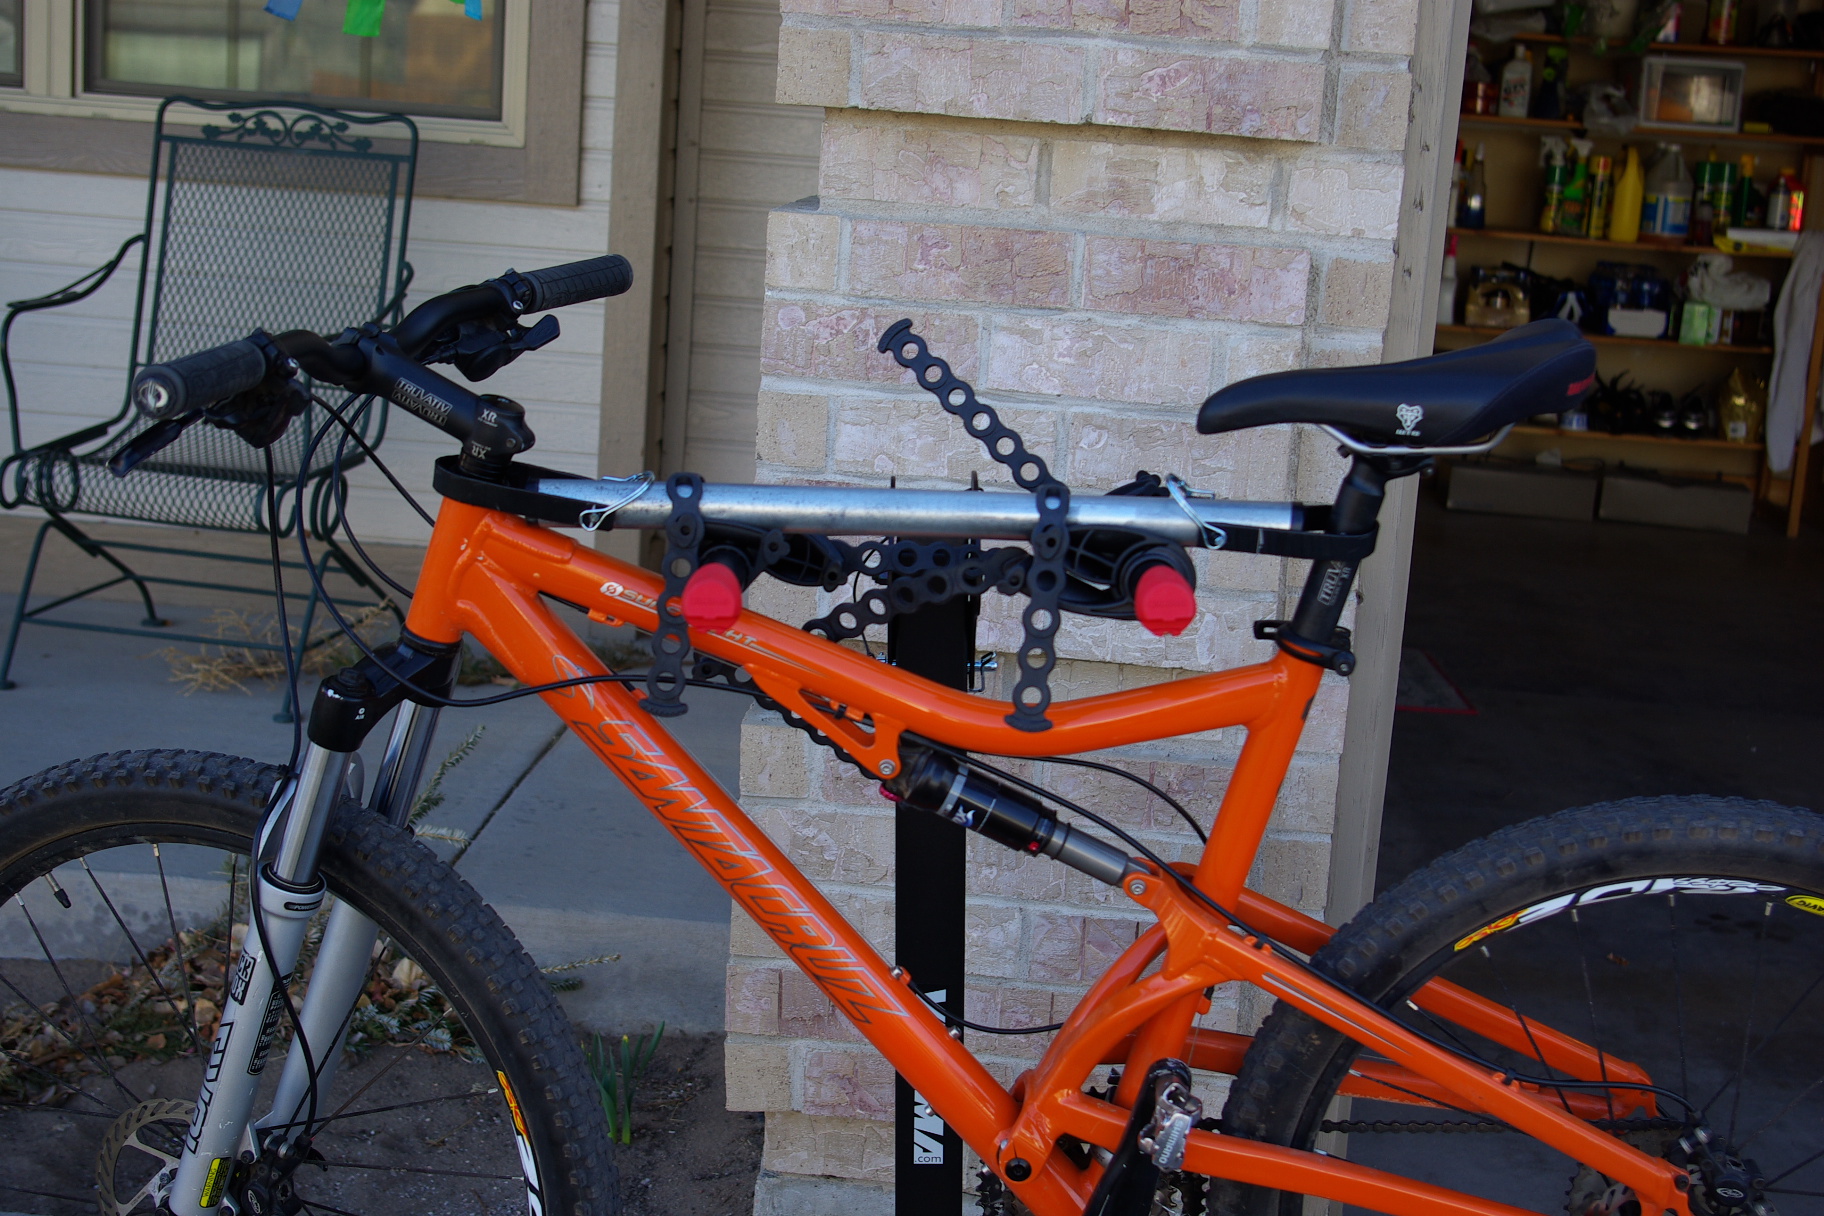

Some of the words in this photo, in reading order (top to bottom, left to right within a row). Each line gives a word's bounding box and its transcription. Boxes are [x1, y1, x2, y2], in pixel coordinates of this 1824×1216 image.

[395, 377, 453, 415] TRUVATIV
[392, 393, 448, 427] TRUVATIV
[481, 408, 498, 423] XR
[471, 445, 487, 460] XR
[915, 1155, 943, 1164] .com
[203, 1167, 217, 1198] WARNING
